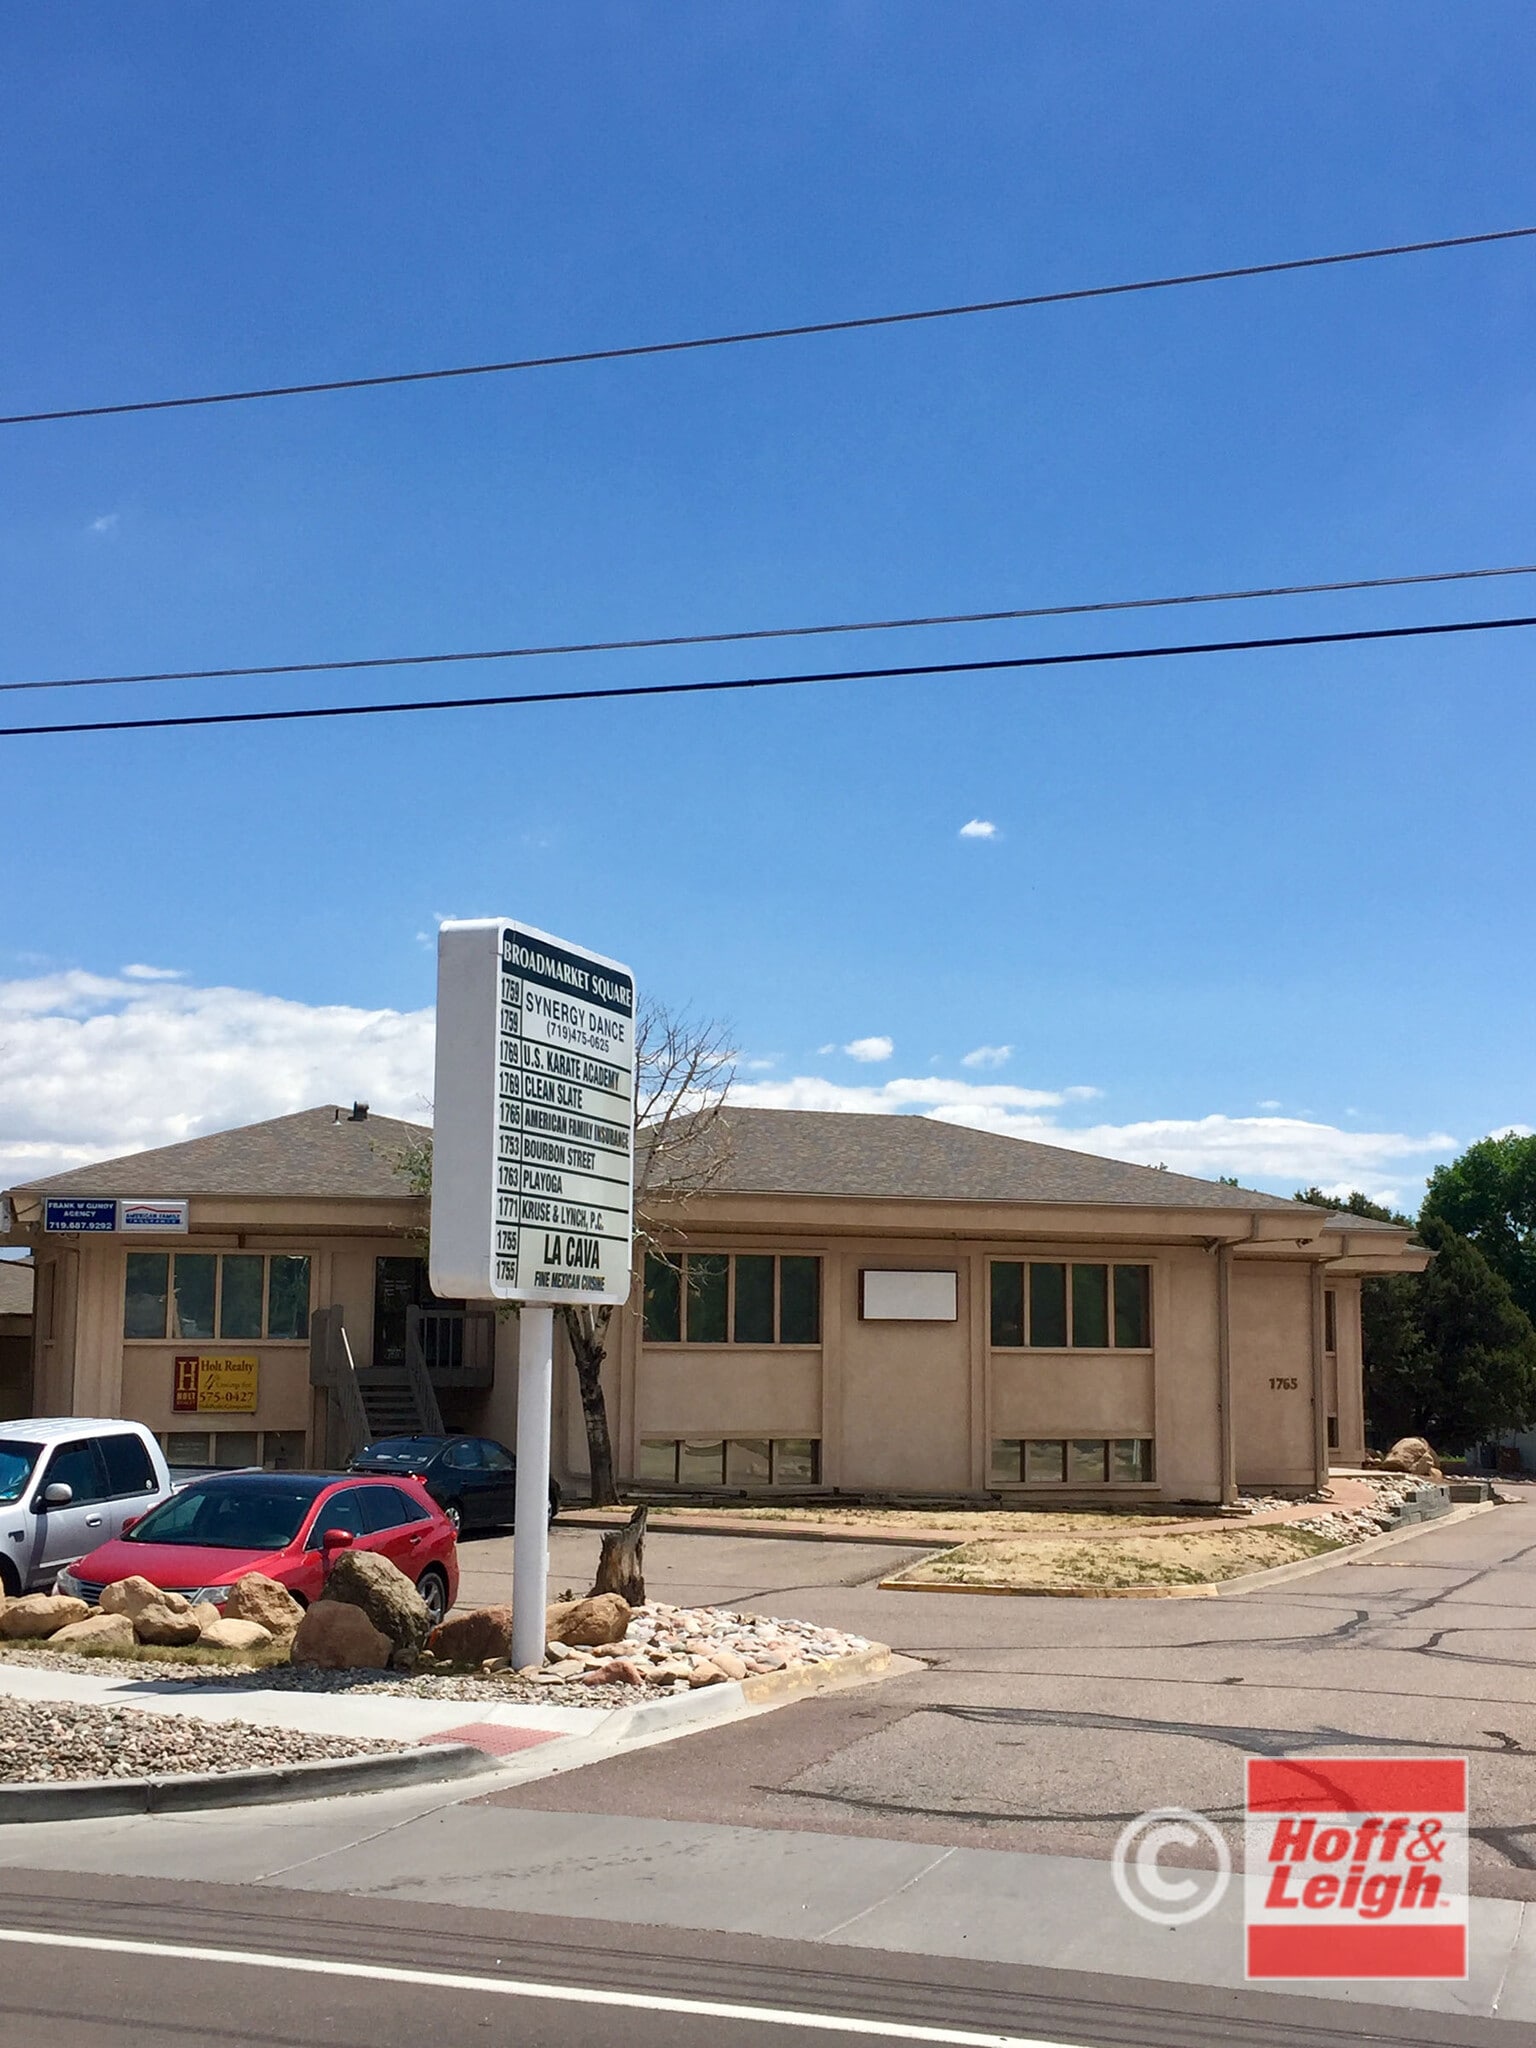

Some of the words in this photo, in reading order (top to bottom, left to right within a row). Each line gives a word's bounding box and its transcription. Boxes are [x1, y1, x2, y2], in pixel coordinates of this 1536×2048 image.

[504, 940, 590, 991] BROADMARKET
[592, 975, 632, 1008] SQUARE
[501, 978, 520, 1003] 1759
[500, 1008, 518, 1033] 1759
[526, 992, 585, 1028] SYNERGY
[589, 1012, 625, 1043] DANCE
[500, 1040, 518, 1064] 1769
[523, 1044, 544, 1070] U.S.
[547, 1051, 581, 1080] KARATE
[582, 1062, 620, 1091] ACADEMY
[500, 1071, 519, 1096] 1769
[525, 1075, 555, 1102] CLEAN
[557, 1084, 583, 1109] SLATE
[500, 1102, 520, 1125] 1765
[525, 1108, 567, 1134] AMERICAN
[569, 1118, 594, 1140] FAMILY
[594, 1125, 629, 1150] INSURANCE
[500, 1135, 519, 1156] 1753
[524, 1138, 565, 1165] BOURBON
[567, 1147, 596, 1170] STREET
[499, 1165, 518, 1187] 1763
[523, 1169, 563, 1194] PLAYOGA
[499, 1197, 518, 1218] 1771
[522, 1200, 551, 1222] KRUSE
[552, 1205, 560, 1223] &
[561, 1206, 588, 1231] LYNCH,
[497, 1230, 517, 1250] 1755
[544, 1234, 561, 1265] LA
[566, 1236, 600, 1269] CAVA
[496, 1260, 515, 1281] 1755
[535, 1271, 550, 1287] FINE
[551, 1272, 580, 1289] MEXICAN
[201, 1360, 221, 1371] Holt
[225, 1360, 255, 1374] Realty
[1268, 1377, 1298, 1390] 1765
